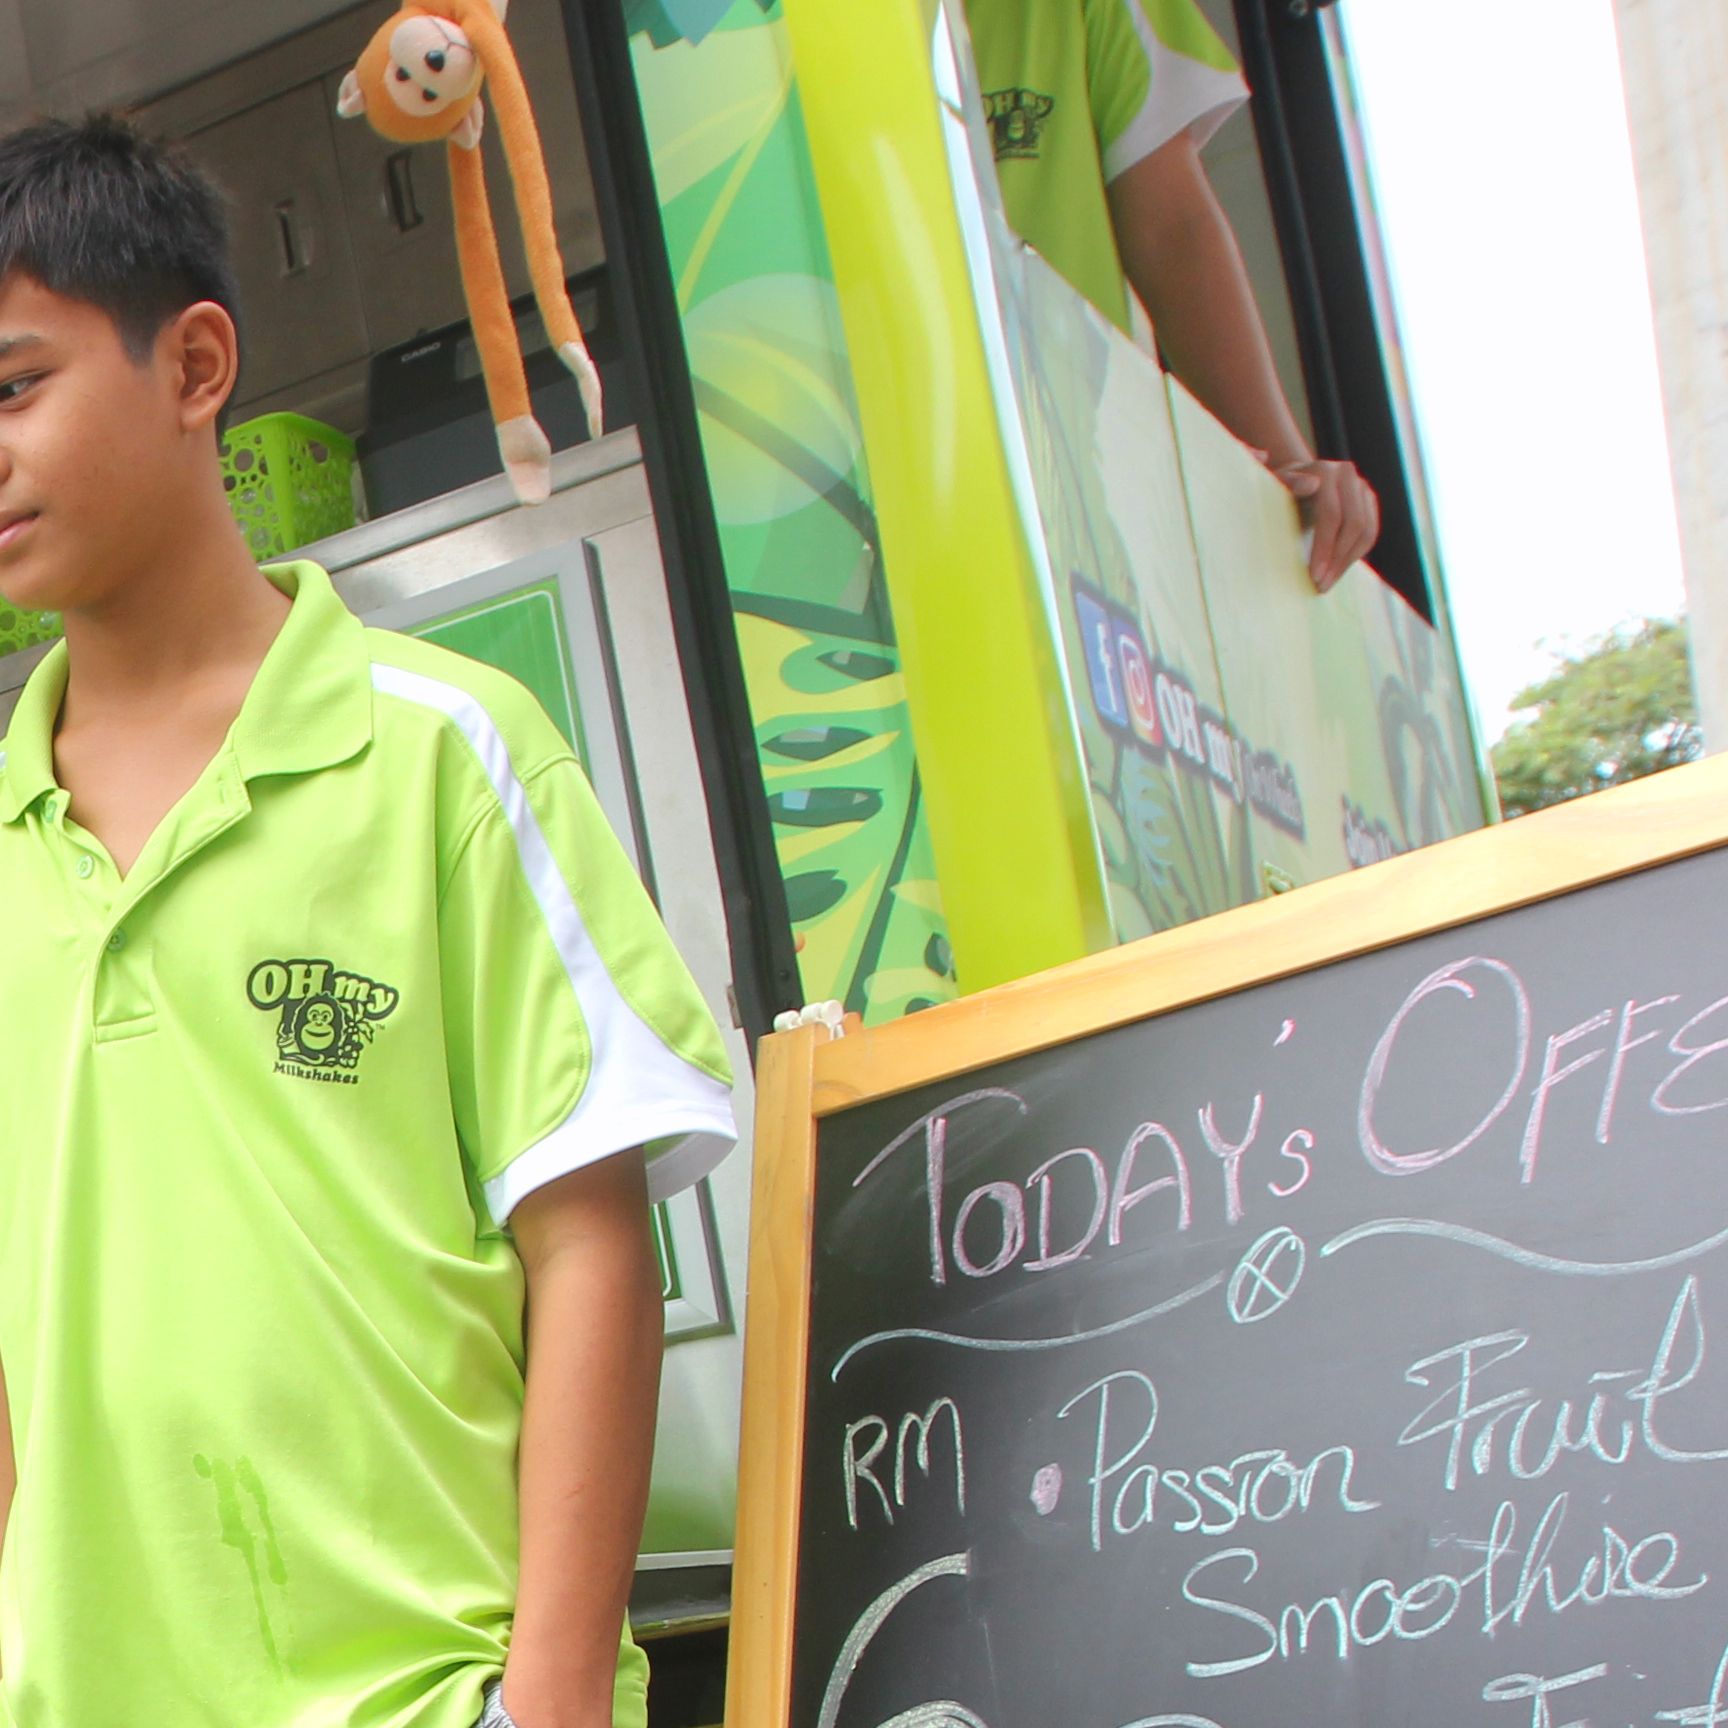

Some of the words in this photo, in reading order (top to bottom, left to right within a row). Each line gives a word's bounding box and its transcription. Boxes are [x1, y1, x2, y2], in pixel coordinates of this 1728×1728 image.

[1155, 673, 1206, 764] OH
[246, 959, 334, 1011] OH
[333, 971, 399, 1021] my
[273, 1061, 360, 1085] Milkshakes
[1056, 1370, 1382, 1550] Passion
[1397, 1275, 1728, 1490] Fruit
[844, 1397, 966, 1529] RM
